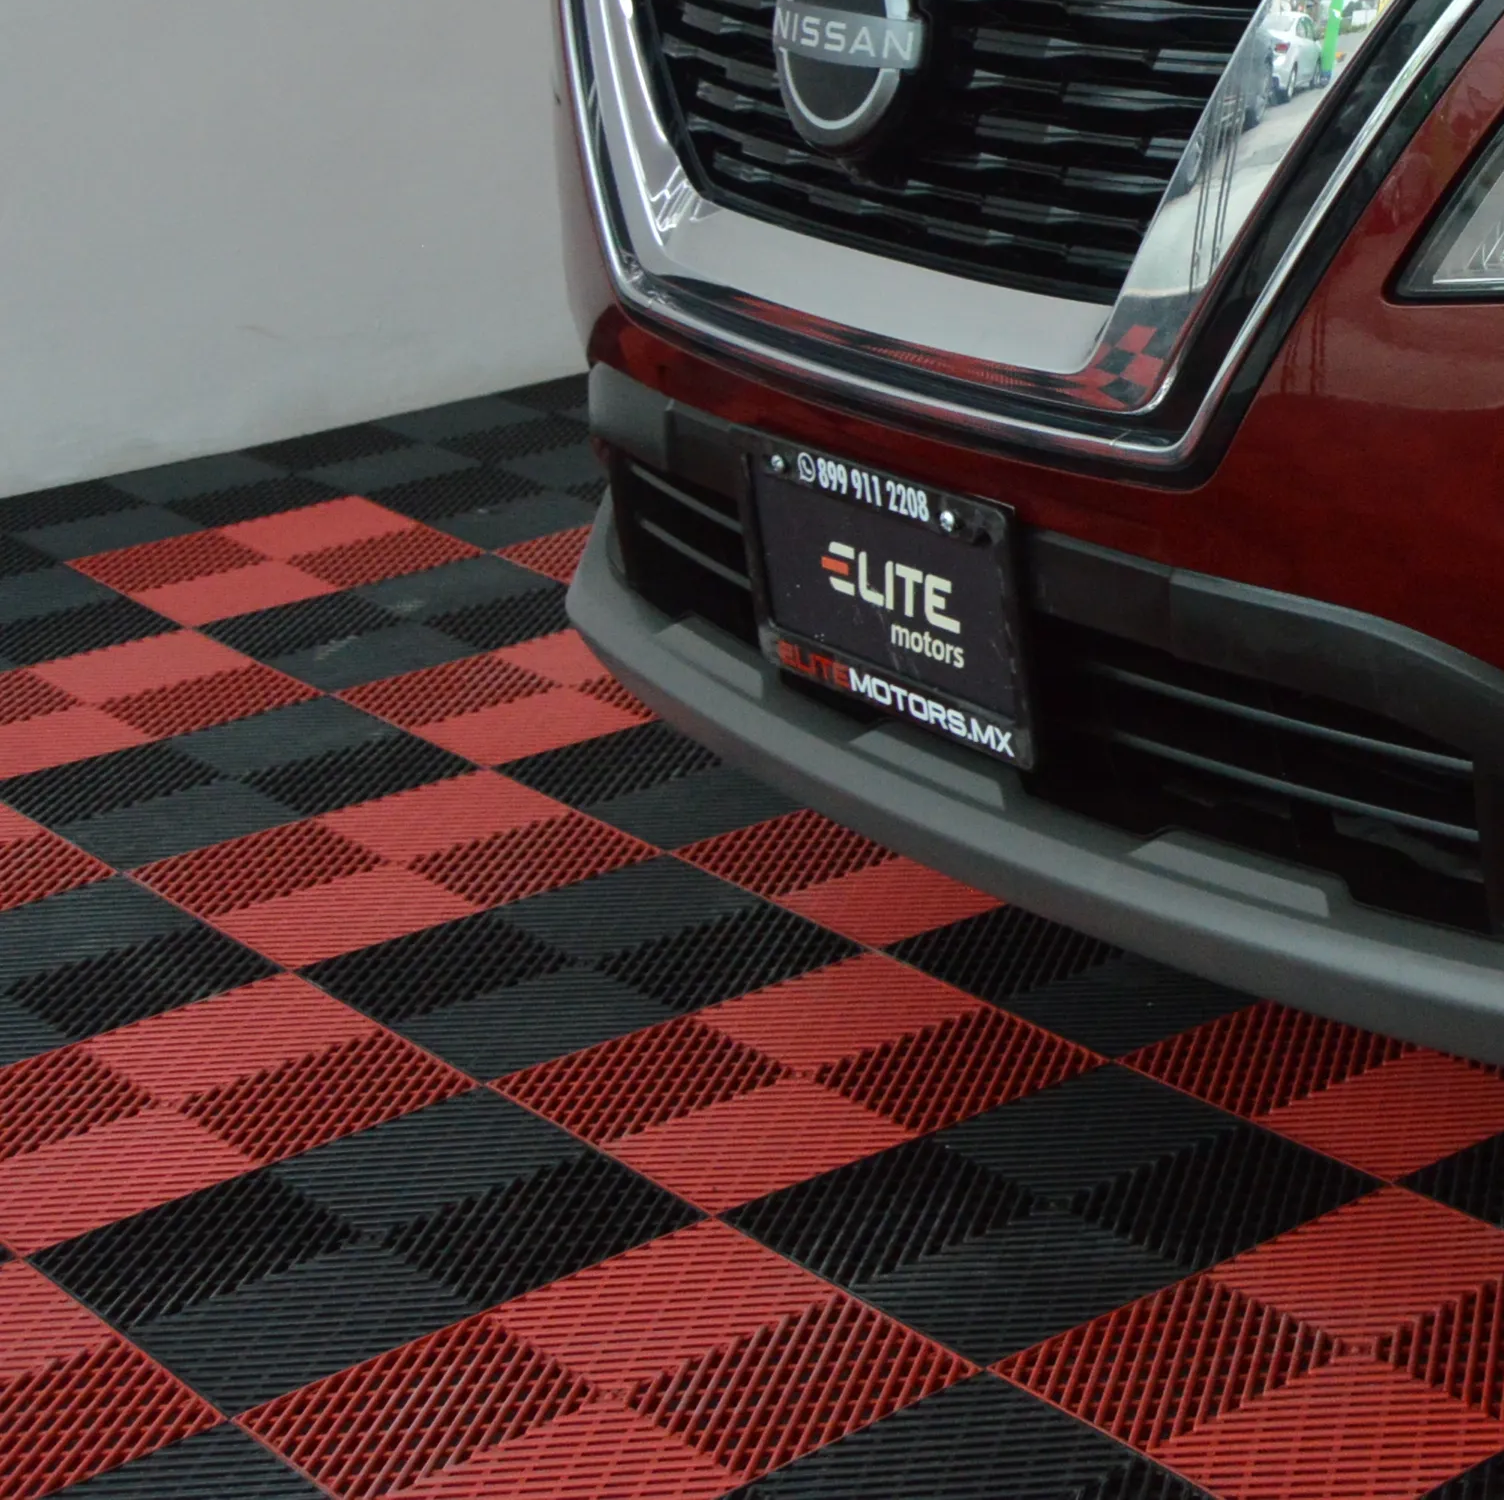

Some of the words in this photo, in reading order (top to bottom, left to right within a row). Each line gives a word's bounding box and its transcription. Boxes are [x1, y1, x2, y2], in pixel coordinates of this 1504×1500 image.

[773, 7, 914, 61] NISSAN
[817, 457, 848, 495] 899
[851, 469, 882, 507] 911
[886, 480, 930, 522] 2208
[821, 541, 961, 634] ELITE
[891, 623, 964, 669] motors
[777, 639, 1015, 758] ELITEMOTORS.MX
